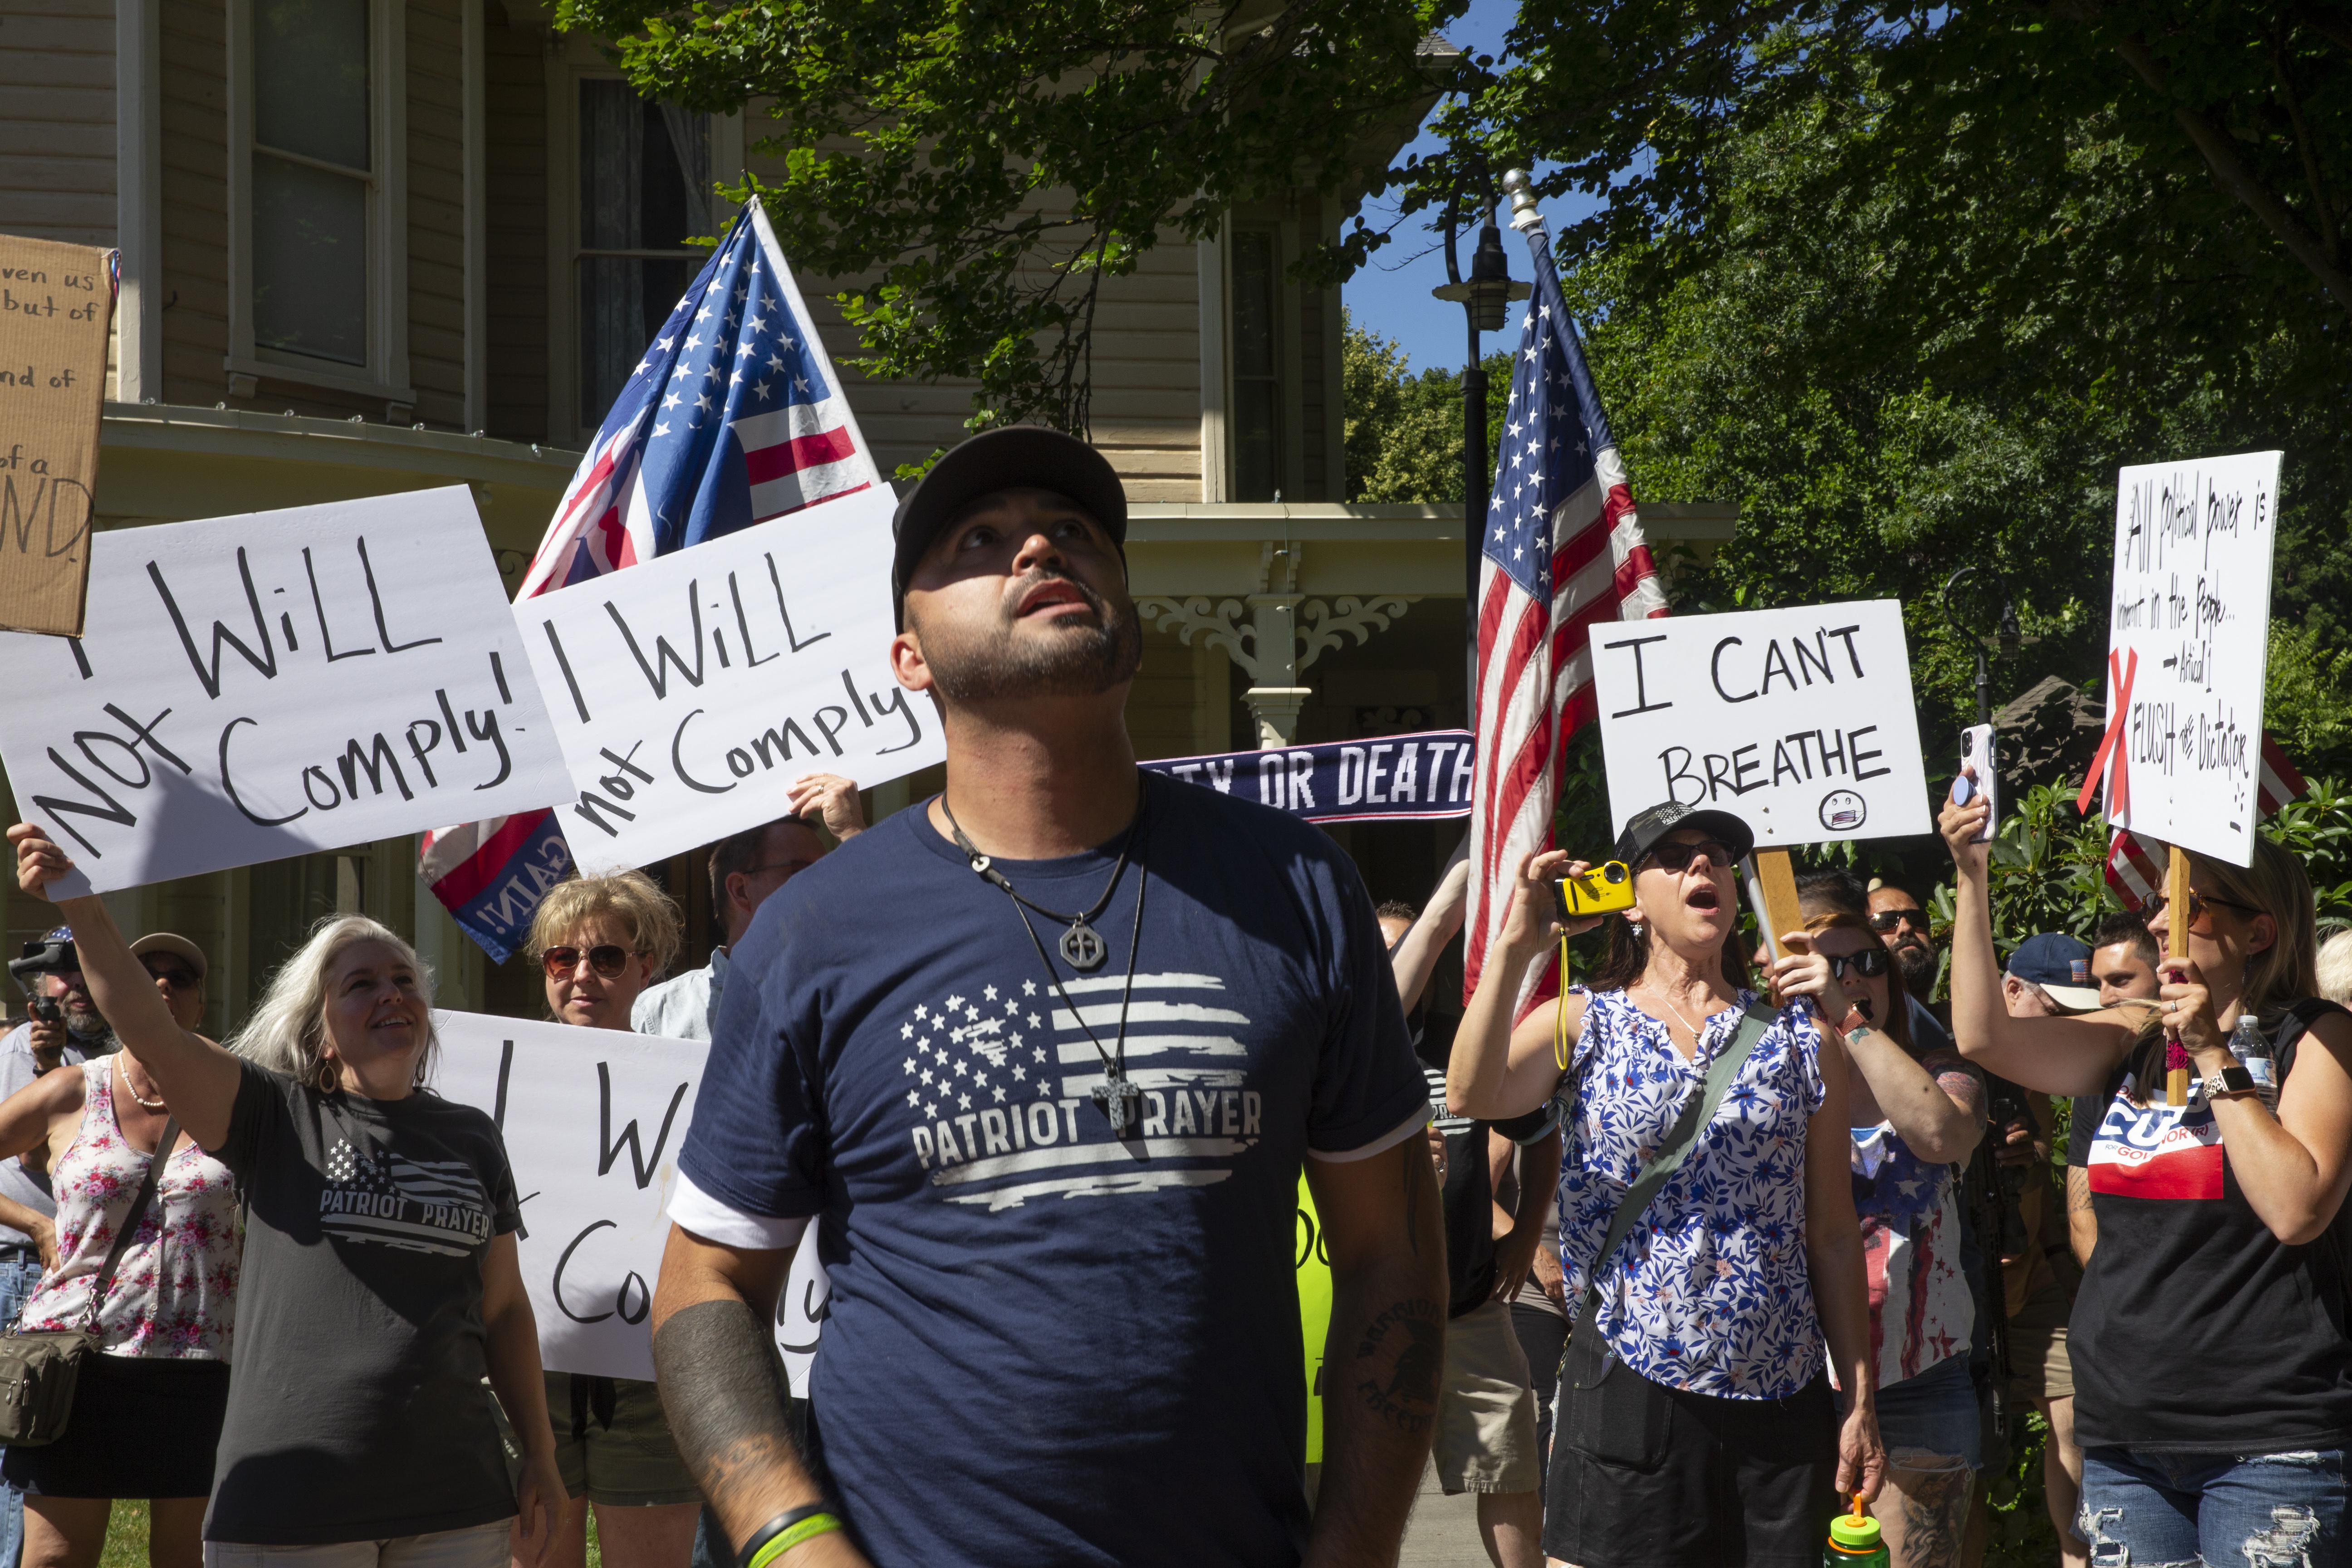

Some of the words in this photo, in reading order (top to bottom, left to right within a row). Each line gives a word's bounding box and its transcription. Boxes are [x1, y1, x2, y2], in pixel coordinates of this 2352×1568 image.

[3, 289, 60, 317] but
[69, 301, 100, 322] of
[64, 274, 94, 291] us
[49, 368, 77, 388] of
[29, 459, 50, 475] a
[2126, 479, 2152, 574] All
[2254, 479, 2266, 530] is
[2151, 588, 2160, 630] in
[2168, 572, 2188, 630] the
[543, 619, 591, 724] I
[1604, 634, 1673, 719] I
[1711, 625, 1865, 703] CAN'T
[1657, 725, 1891, 808] BREATHE
[2132, 701, 2176, 777] FLUSH
[1150, 759, 1234, 795] TY
[1259, 750, 1315, 810] OR
[1338, 742, 1475, 806] DEATH
[912, 1098, 1080, 1170] PATRIOT
[1118, 1090, 1262, 1138] PRAYER
[319, 1189, 408, 1220] PATRIOT
[421, 1203, 490, 1239] PRAYER
